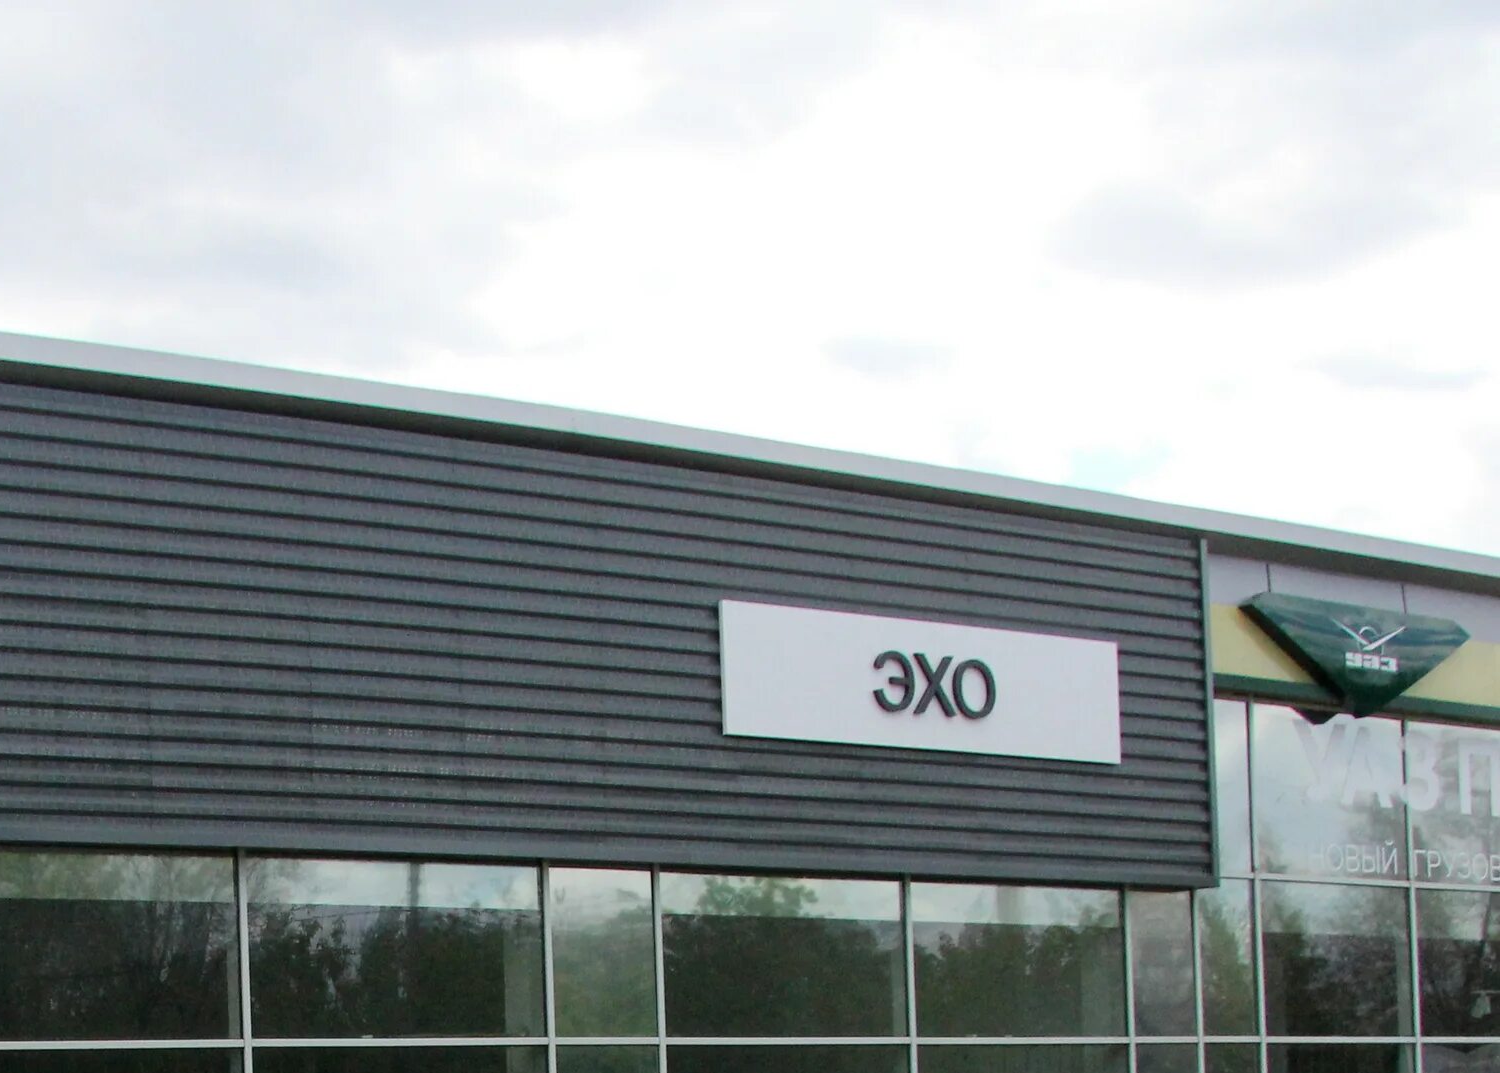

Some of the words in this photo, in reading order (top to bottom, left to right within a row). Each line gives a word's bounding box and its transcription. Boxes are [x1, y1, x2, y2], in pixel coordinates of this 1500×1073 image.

[873, 650, 996, 719] ЭХО
[1292, 718, 1440, 812] УАЗ
[1308, 840, 1398, 875] НОВЫЙ
